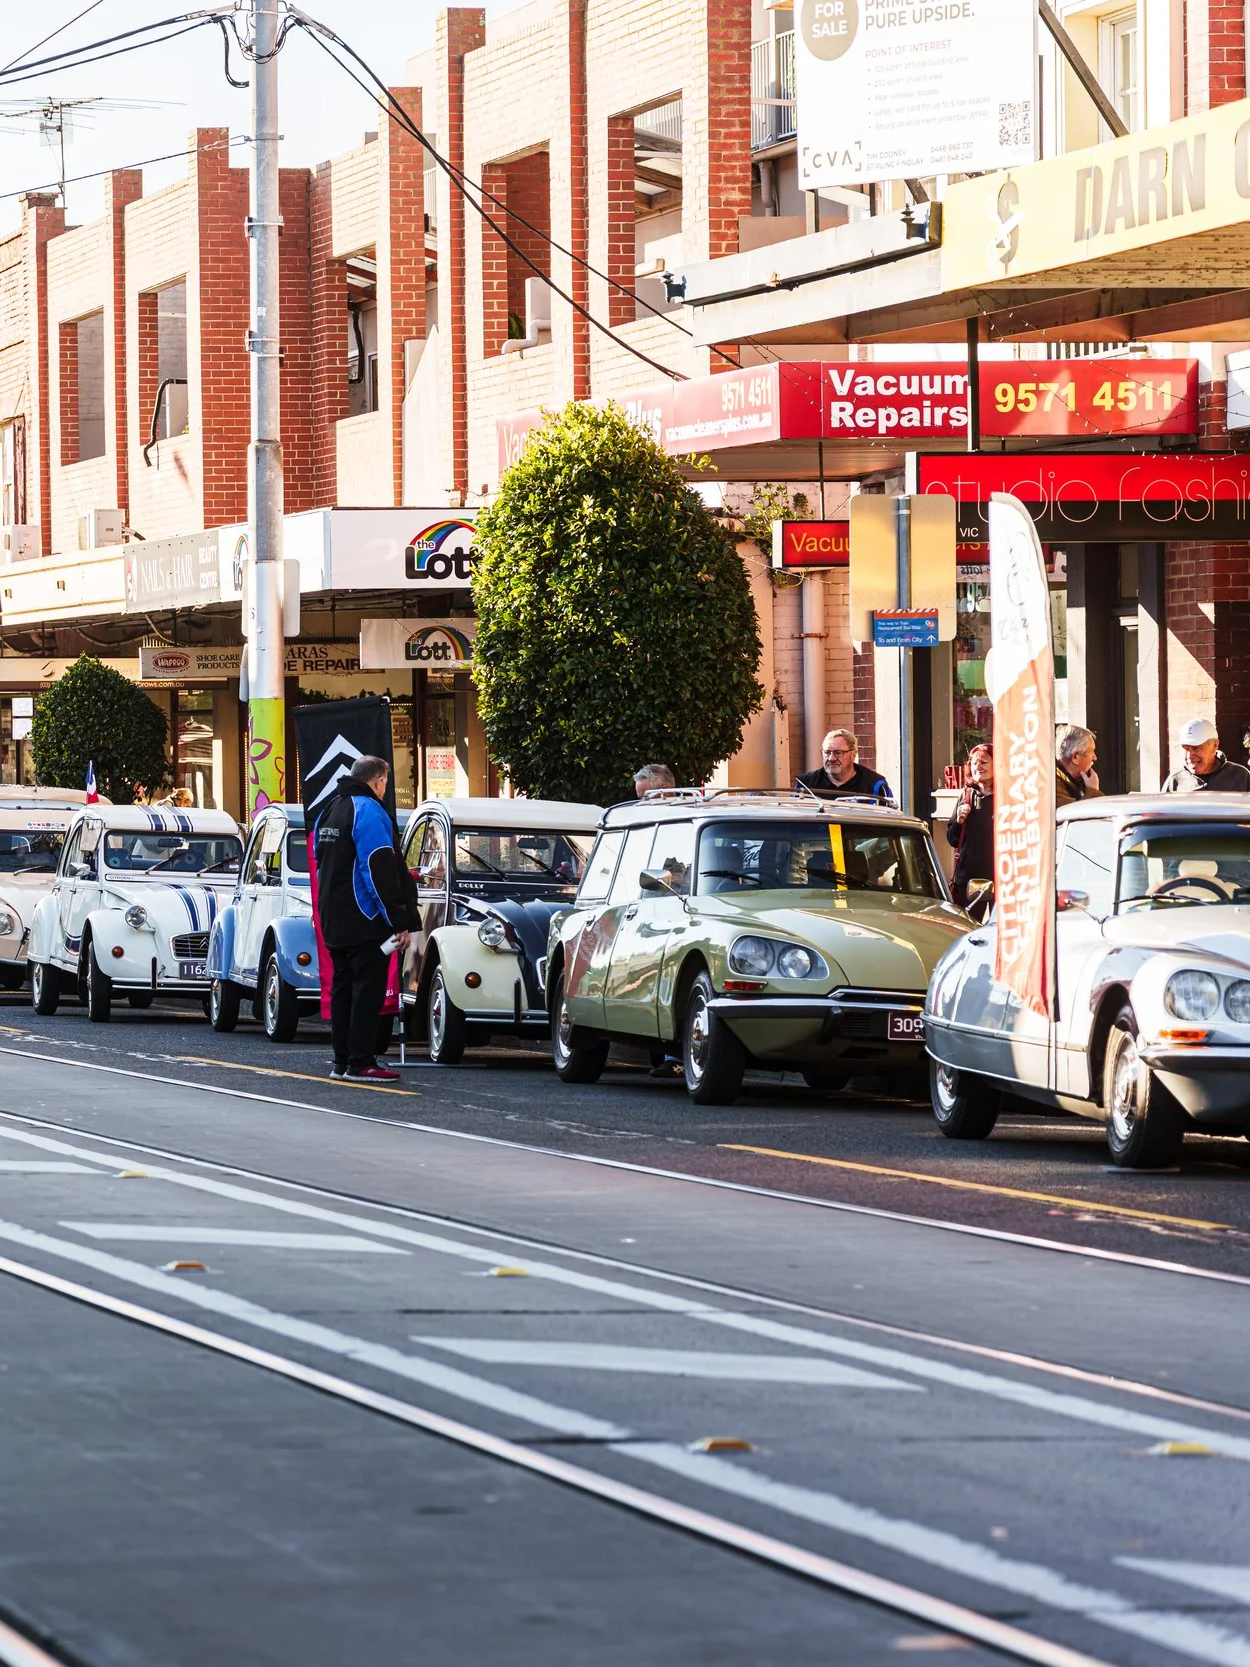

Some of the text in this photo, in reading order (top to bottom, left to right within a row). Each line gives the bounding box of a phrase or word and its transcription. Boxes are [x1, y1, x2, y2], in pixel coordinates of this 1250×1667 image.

[814, 1, 845, 19] FOR
[865, 1, 976, 31] PURE UPSIDE.
[812, 20, 848, 39] SALE
[865, 39, 952, 59] POINT OF INTEREST
[866, 157, 925, 172] STIRLING FINDLAY
[1073, 132, 1207, 243] DARN
[828, 369, 969, 396] Vacuum
[721, 376, 772, 412] 9571 4511
[994, 381, 1173, 413] 9571 4511
[830, 401, 969, 434] Repairs
[1119, 466, 1250, 523] fashi
[959, 527, 979, 538] VIC
[417, 539, 435, 549] the
[791, 533, 849, 552] Vacu
[140, 556, 165, 594] NAILS
[173, 554, 195, 591] HAIR
[196, 654, 218, 662] SHOE
[218, 653, 239, 661] CARE
[286, 646, 329, 659] ARAS
[197, 661, 240, 670] PRODUCTS
[184, 964, 207, 975] 1162
[893, 1017, 923, 1033] 309
